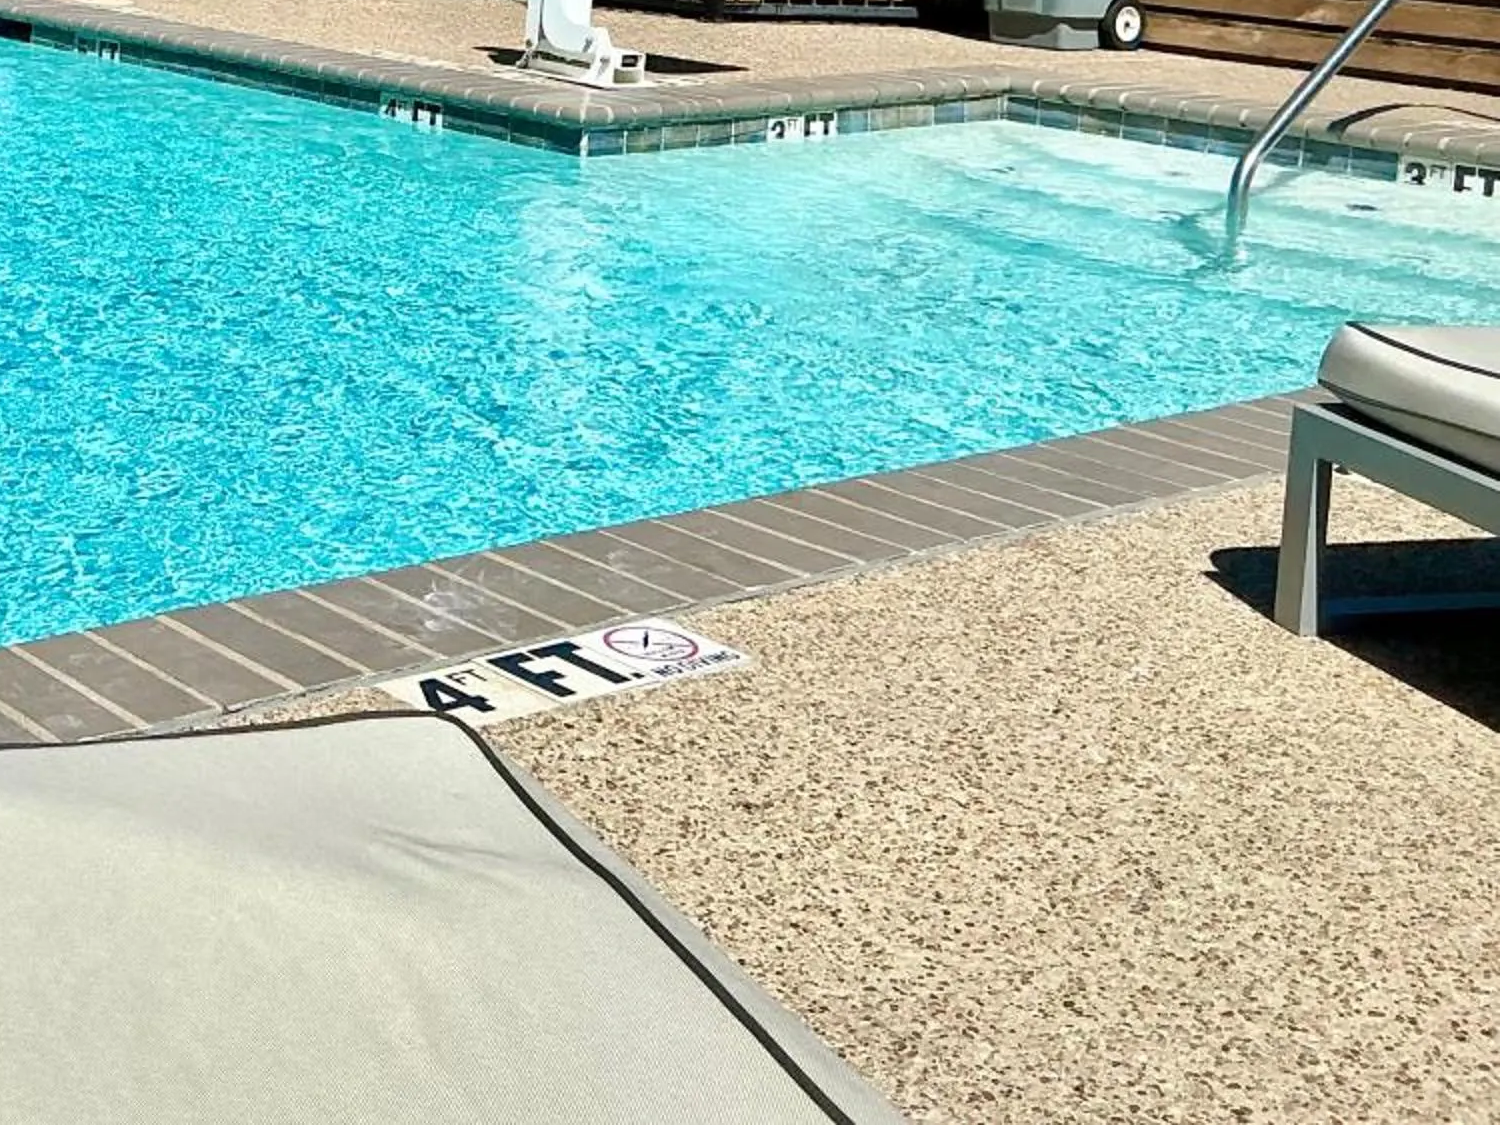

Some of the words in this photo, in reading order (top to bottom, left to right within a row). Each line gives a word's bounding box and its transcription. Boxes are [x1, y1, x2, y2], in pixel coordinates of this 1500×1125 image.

[1453, 164, 1500, 197] FT
[445, 668, 489, 688] FT
[419, 677, 496, 714] 4
